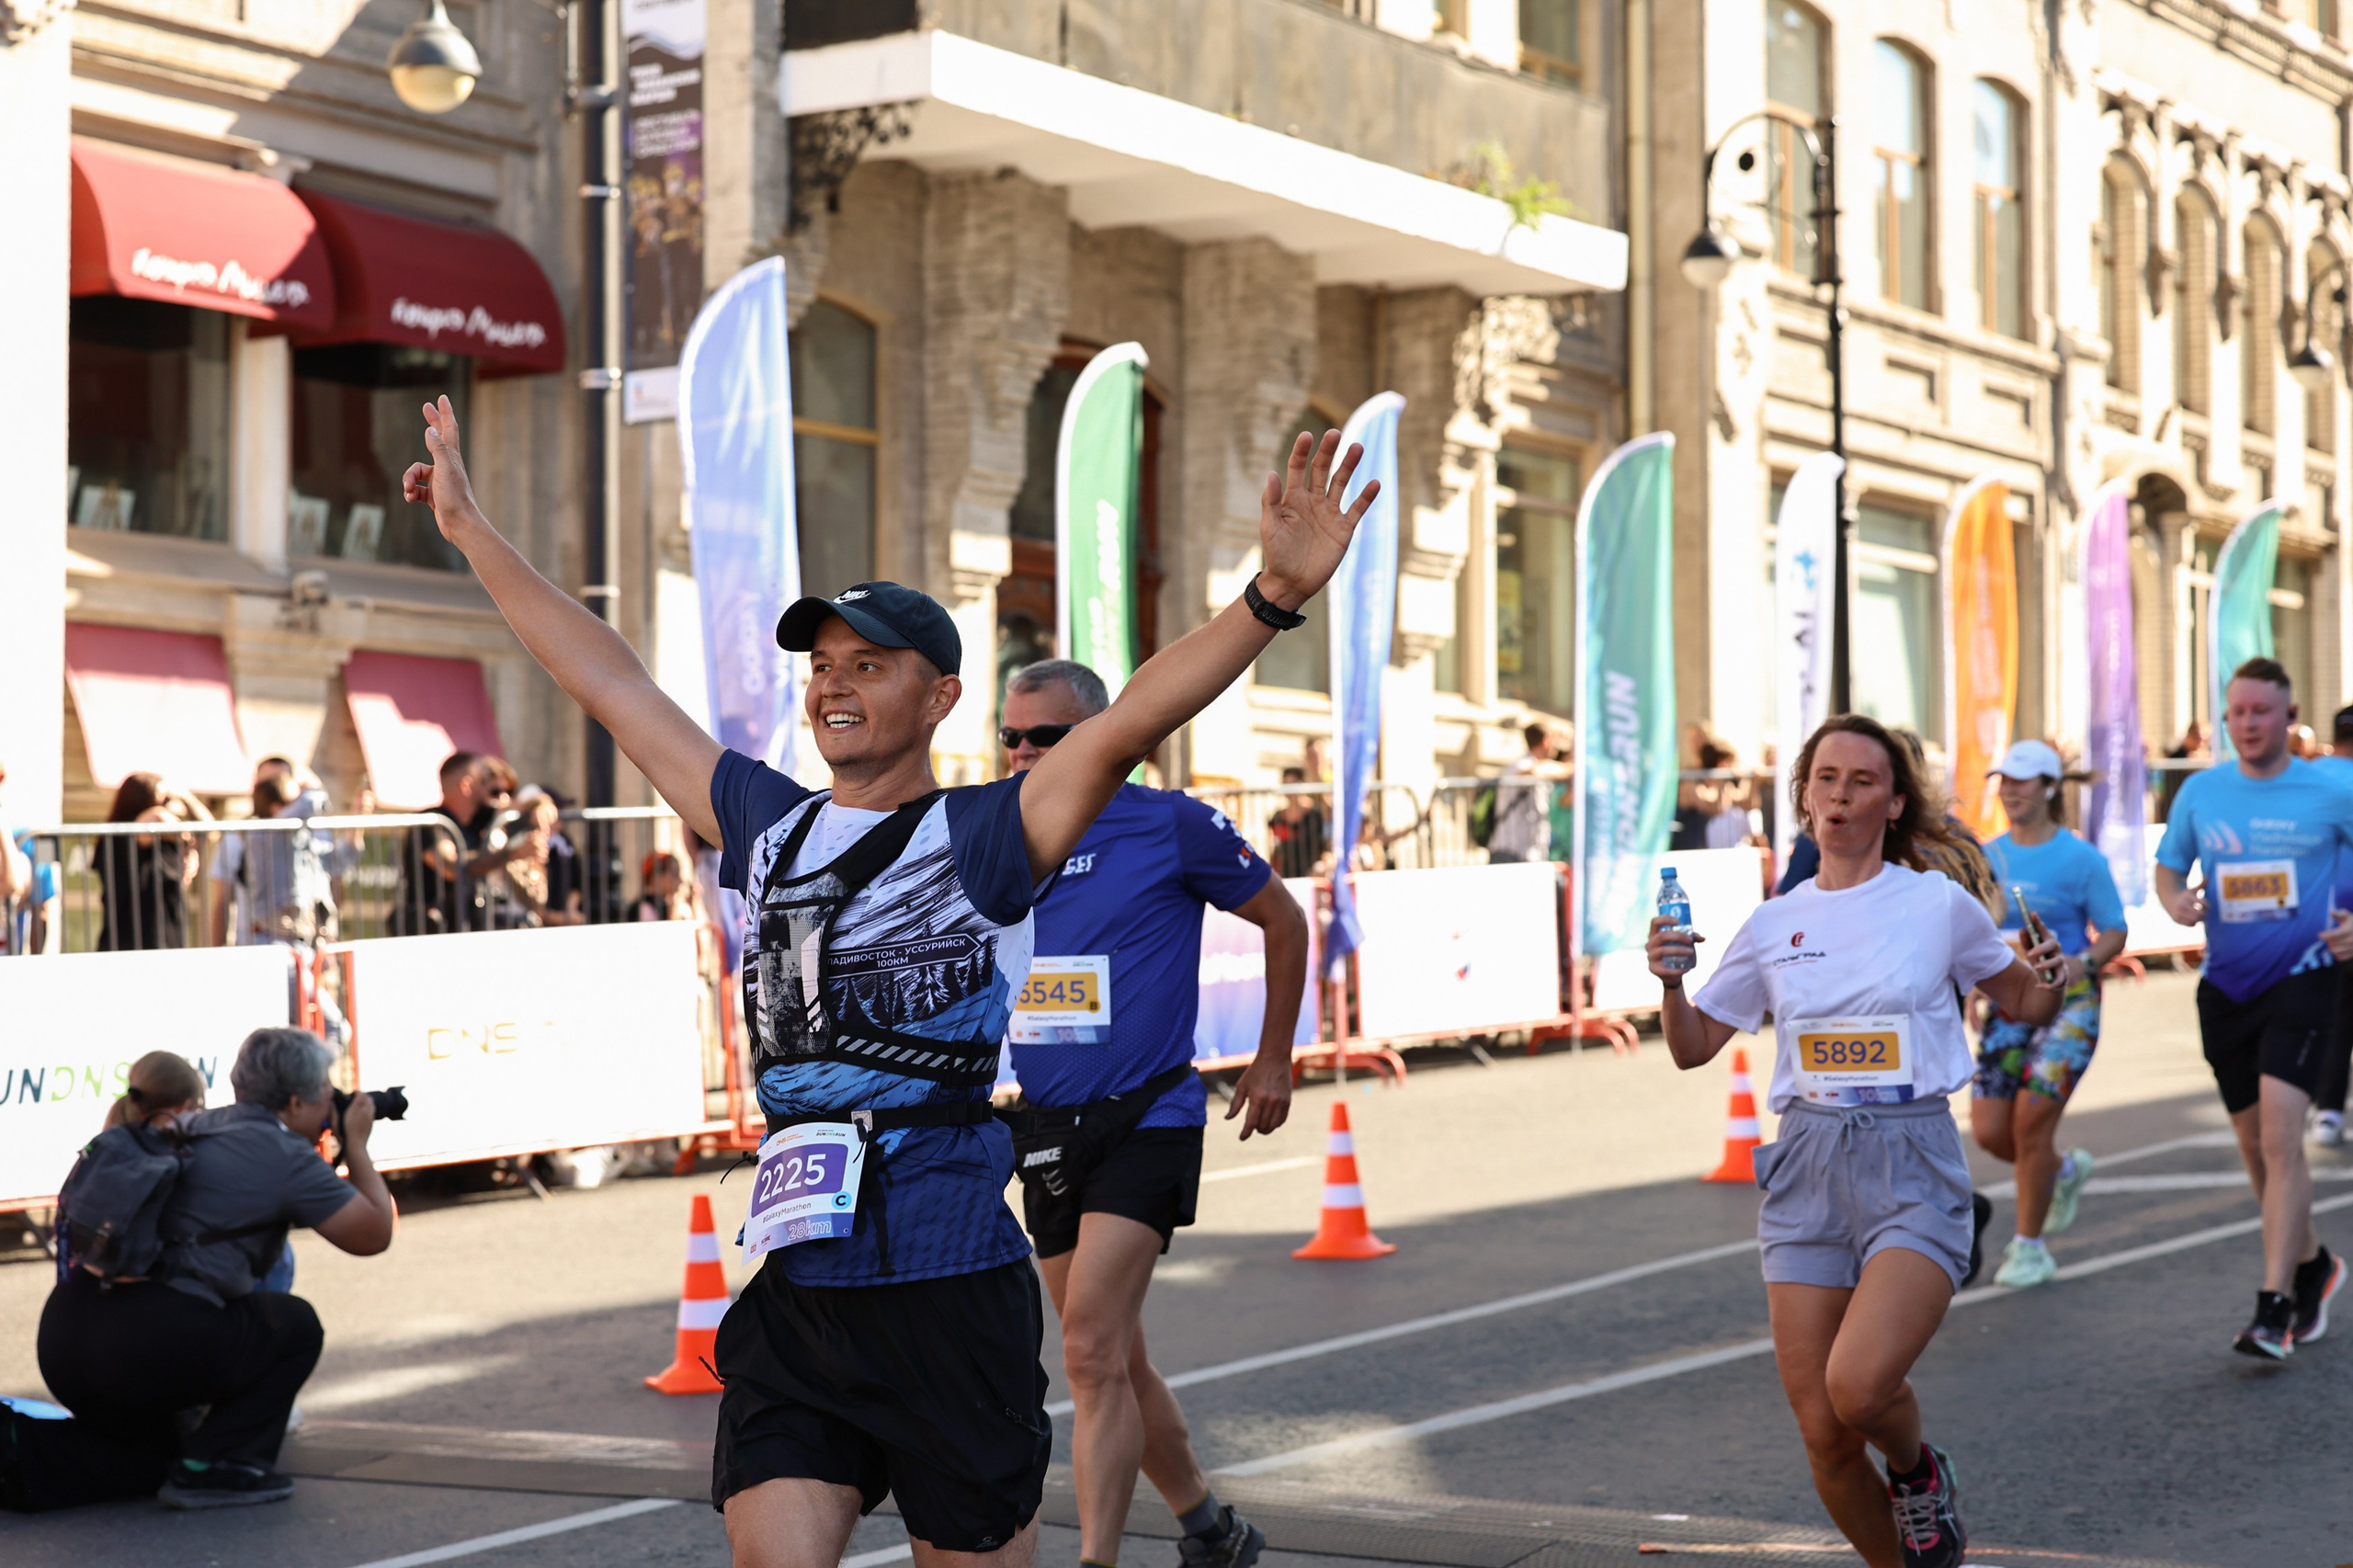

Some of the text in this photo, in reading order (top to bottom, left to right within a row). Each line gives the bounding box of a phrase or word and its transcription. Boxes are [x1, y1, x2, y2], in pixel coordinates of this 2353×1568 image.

[827, 949, 896, 966] ЛАДИВОСТОК
[904, 937, 966, 955] УССУРИЙСК
[876, 957, 909, 968] 100КМ
[427, 1022, 518, 1060] DNS
[1813, 1040, 1887, 1064] 5892
[1023, 1146, 1063, 1168] NIKE
[758, 1153, 826, 1204] 2225
[835, 1195, 847, 1207] C
[762, 1202, 812, 1223] #GalaxyMarathon
[788, 1220, 832, 1241] 28km
